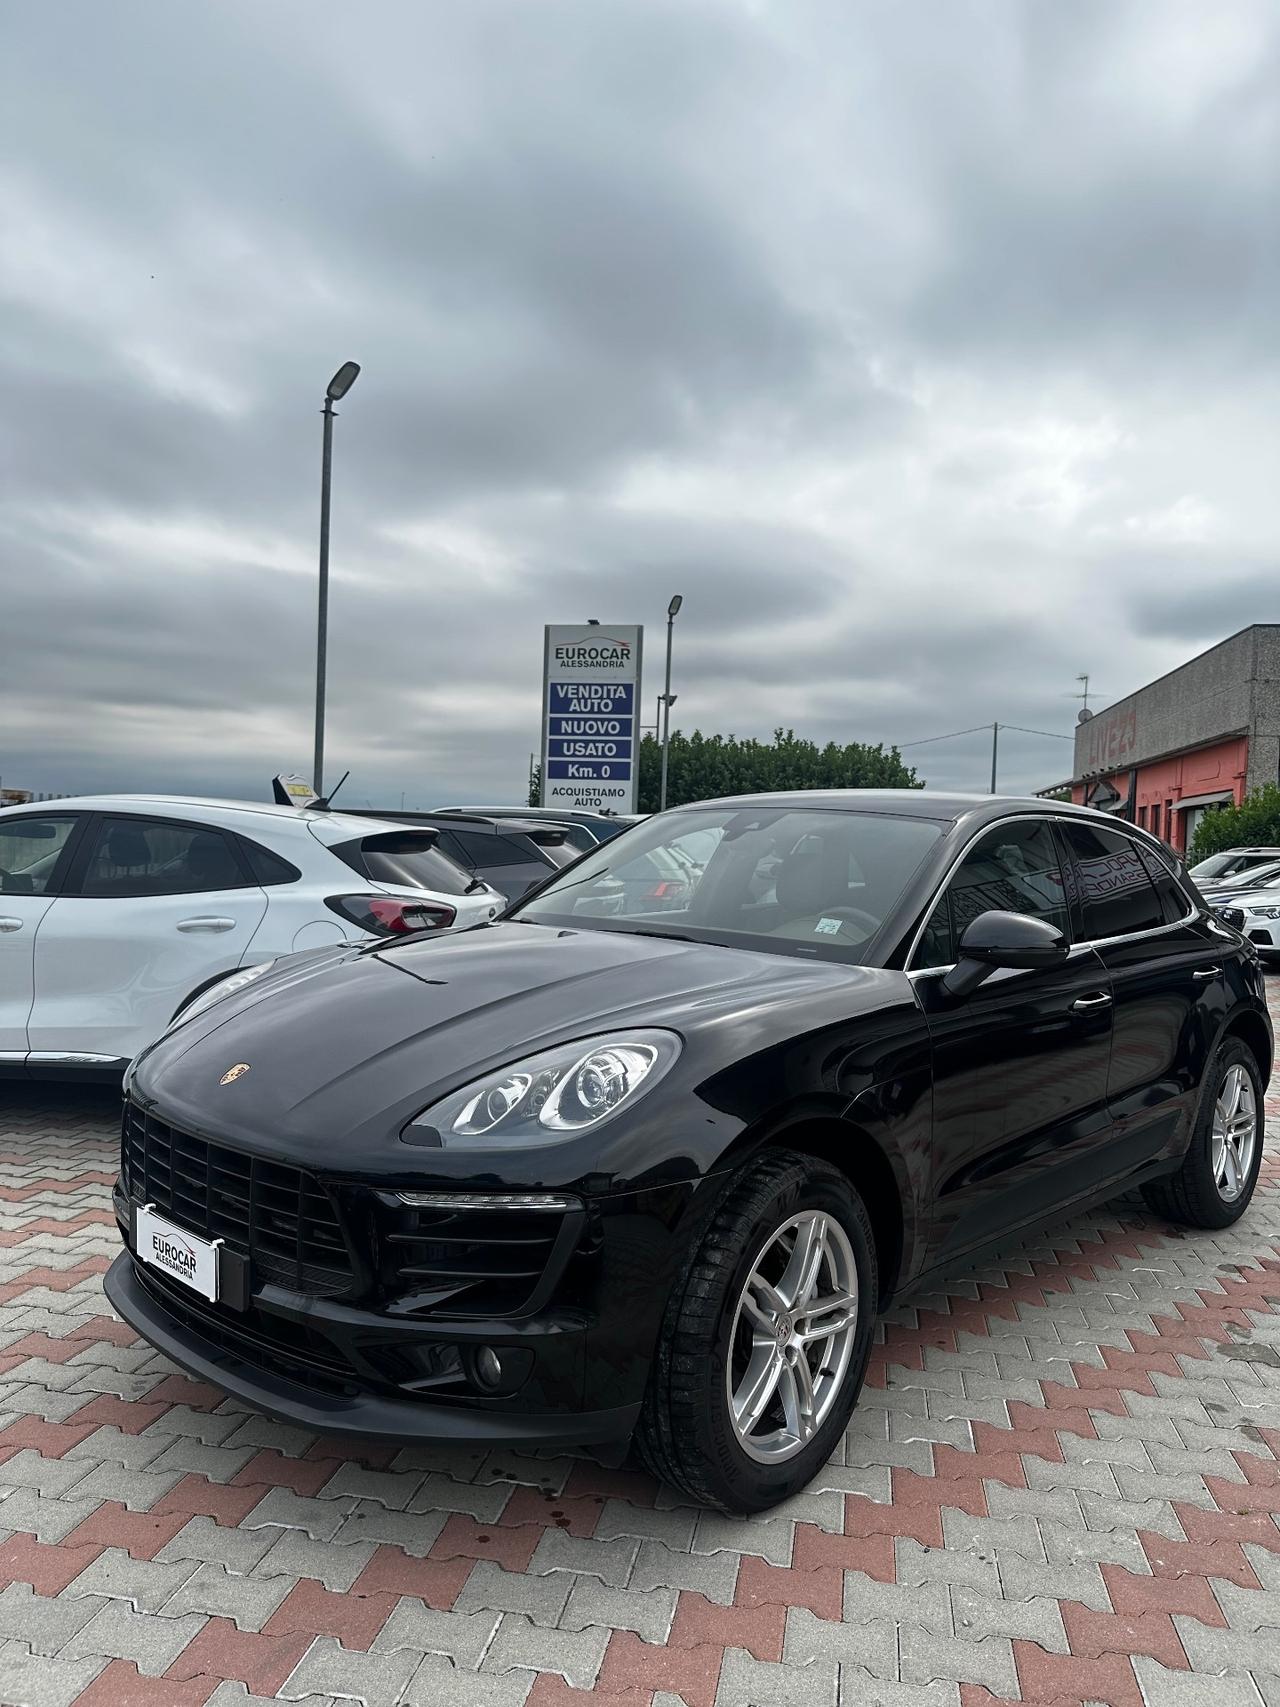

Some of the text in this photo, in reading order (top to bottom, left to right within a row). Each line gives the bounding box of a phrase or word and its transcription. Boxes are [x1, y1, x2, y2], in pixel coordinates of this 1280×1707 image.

[555, 647, 631, 660] EUROCAR
[560, 660, 625, 668] ALESSANDRIA
[556, 685, 627, 699] VENDITA
[569, 698, 613, 712] AUTO
[561, 720, 620, 734] NUOVO
[563, 742, 617, 756] USATO
[568, 764, 611, 778] Km. 0
[552, 787, 626, 797] ACQUISTIAMO
[574, 798, 602, 807] AUTO
[152, 1235, 197, 1273] EUROCAR
[155, 1252, 194, 1280] ALESSANDRIA
